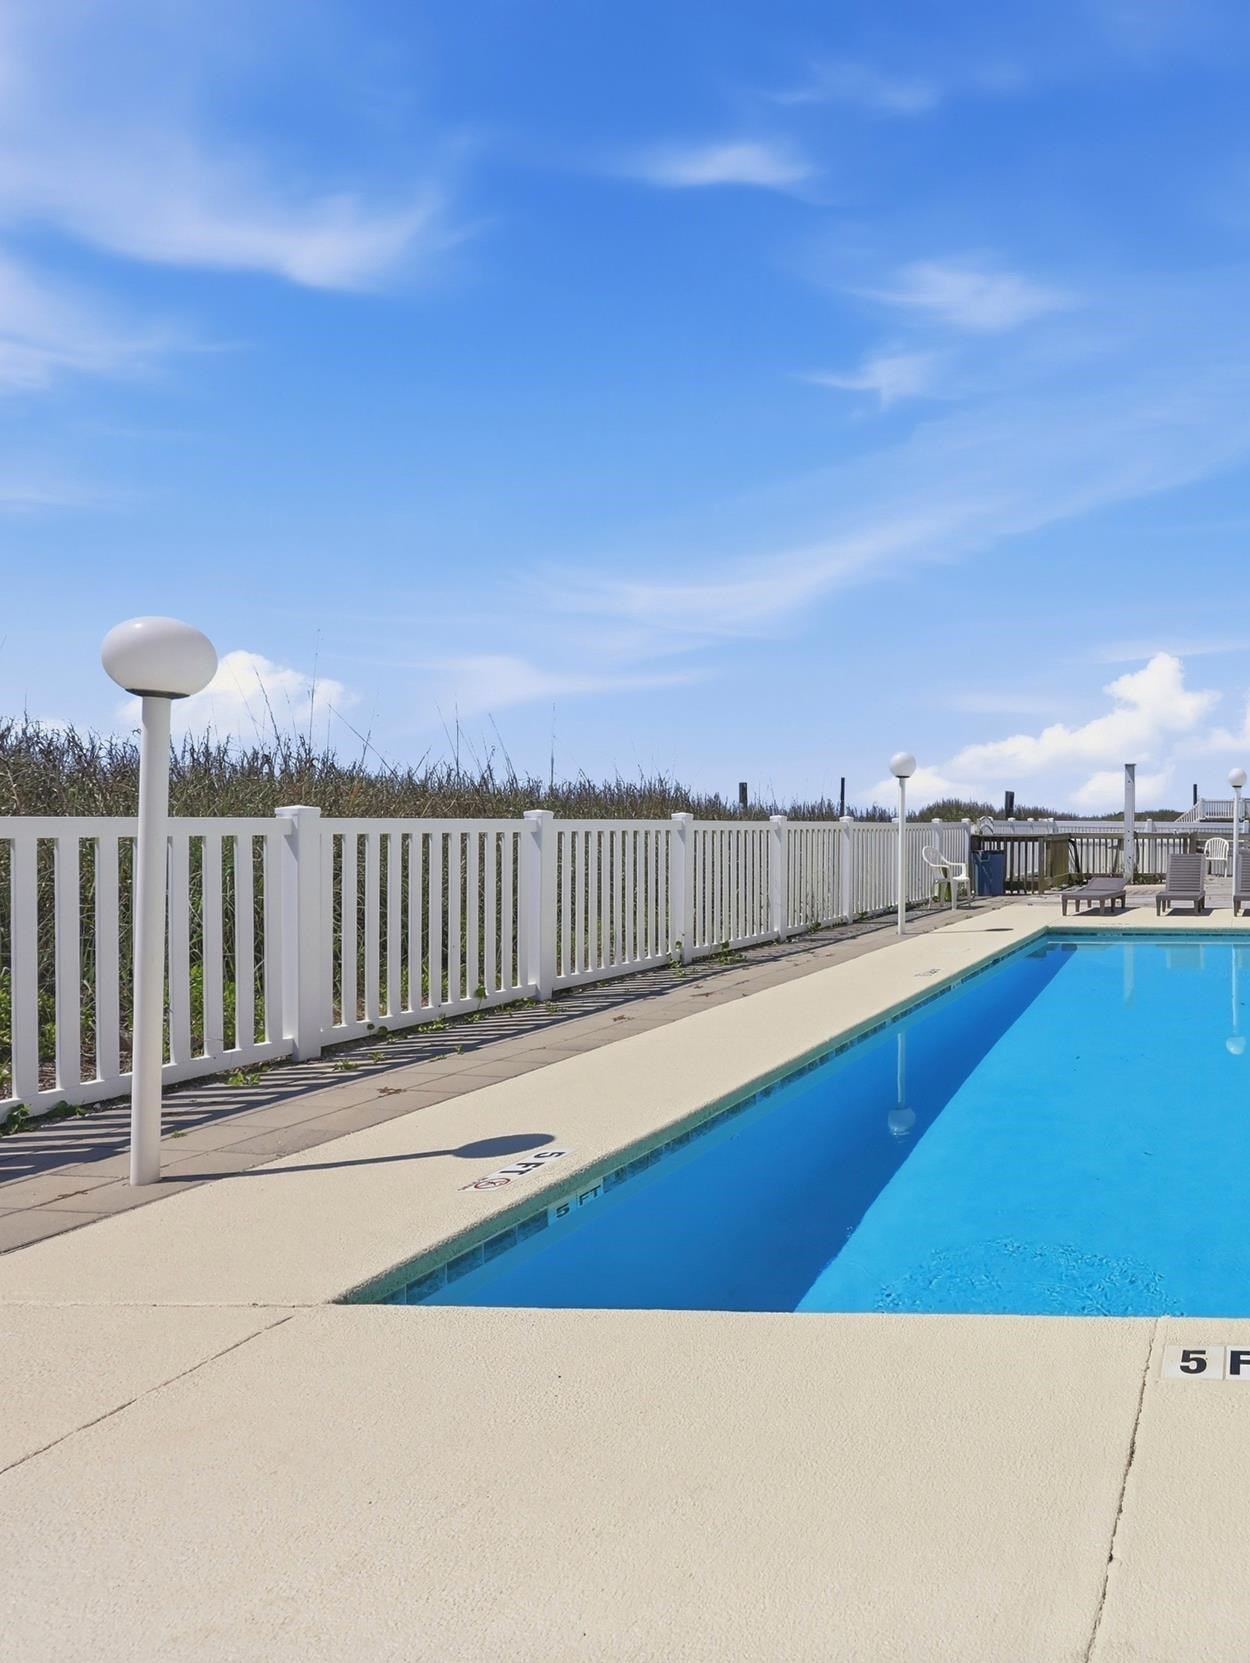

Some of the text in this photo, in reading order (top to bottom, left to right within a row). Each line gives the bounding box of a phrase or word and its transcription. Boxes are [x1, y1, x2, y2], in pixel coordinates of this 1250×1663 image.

[500, 1151, 566, 1175] 5 FT
[556, 1184, 601, 1218] 5 FT
[1180, 1349, 1207, 1374] 5
